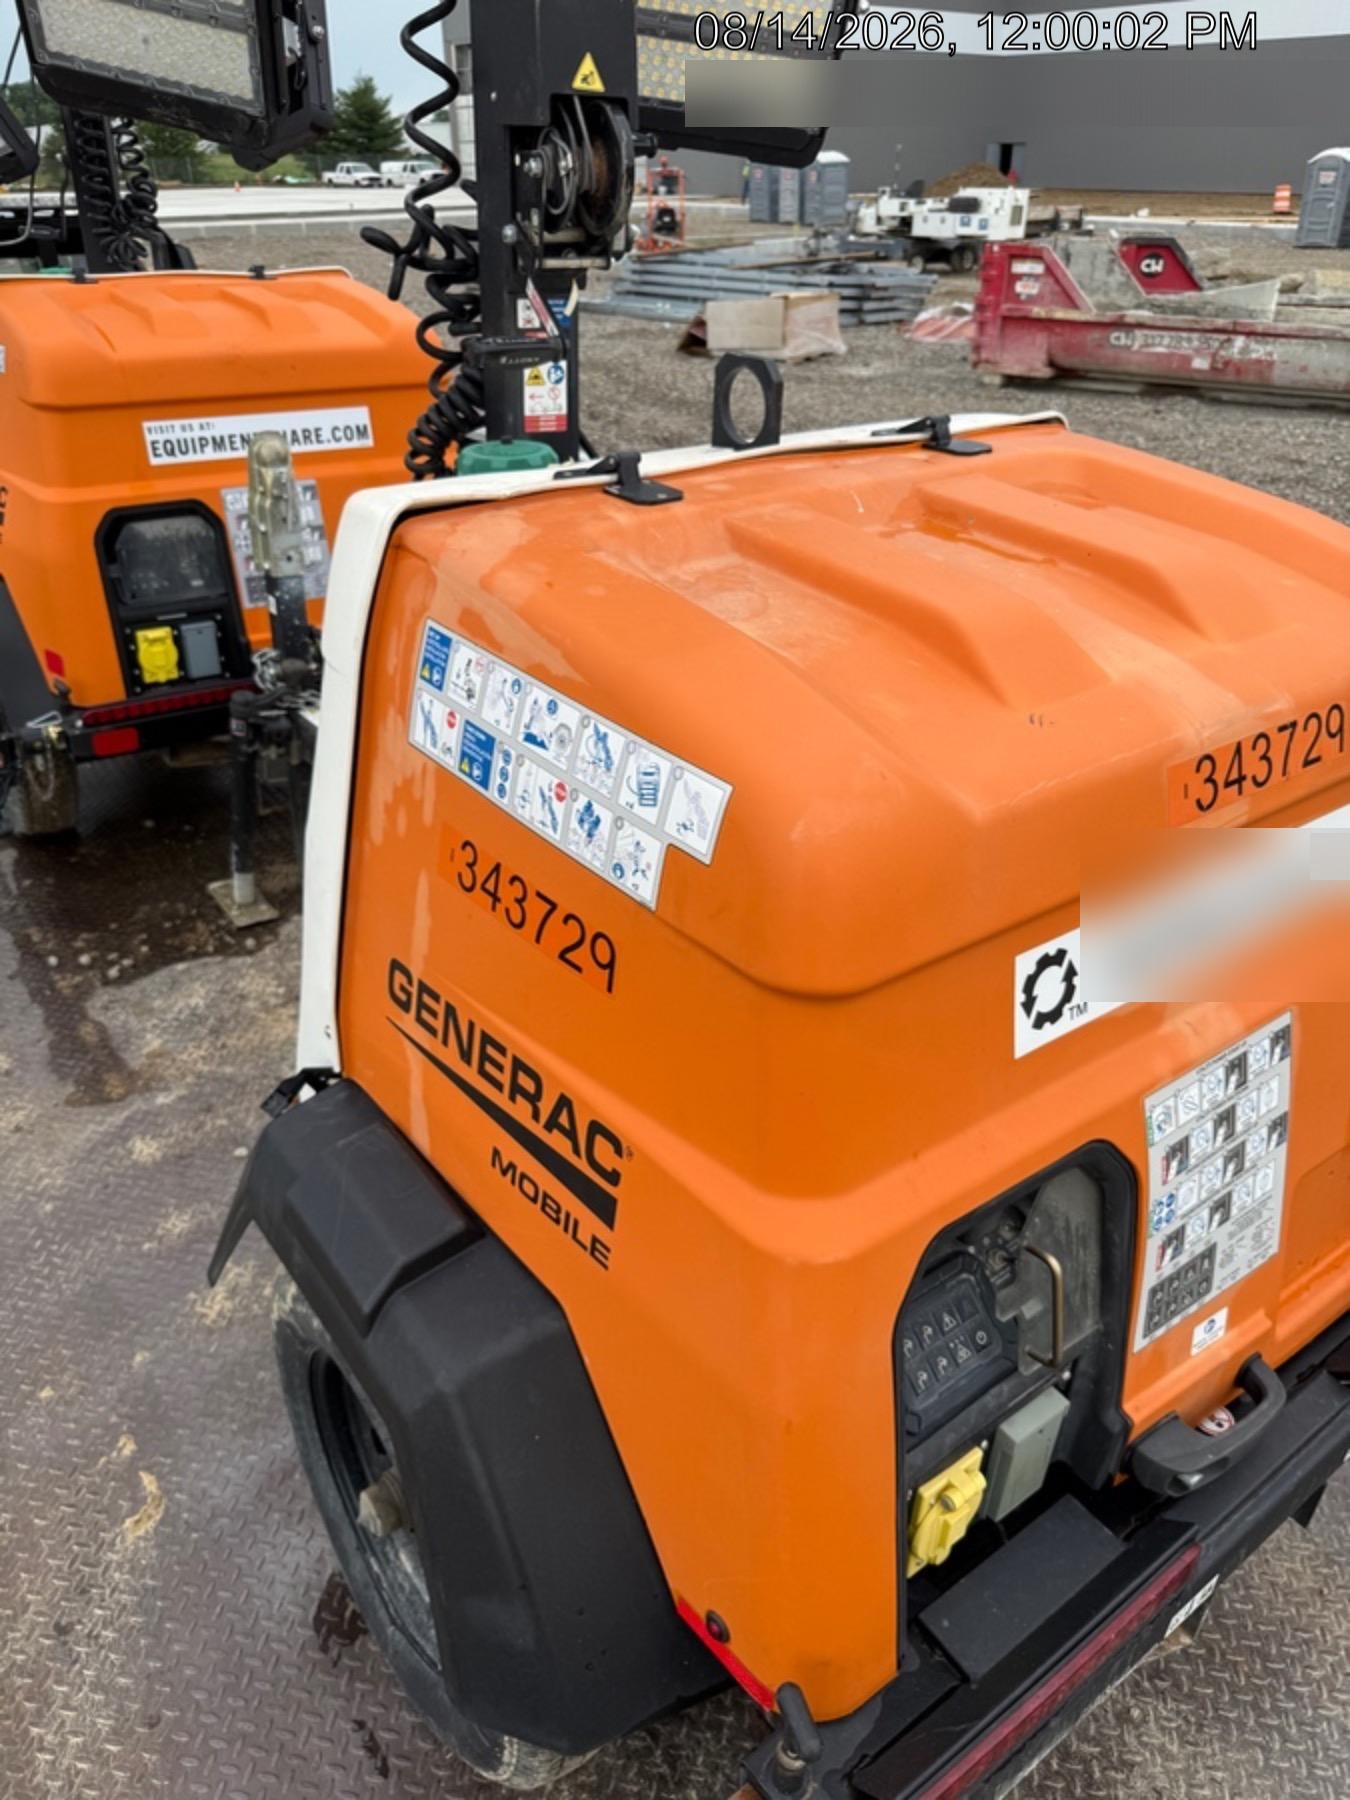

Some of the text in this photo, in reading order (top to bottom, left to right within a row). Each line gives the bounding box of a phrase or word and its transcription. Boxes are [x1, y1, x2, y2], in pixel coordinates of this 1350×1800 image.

[146, 424, 175, 435] VISIT
[180, 423, 194, 433] US
[151, 424, 369, 458] EQUIPMENARE.COM
[1195, 703, 1344, 812] 343729
[457, 839, 616, 993] 343729
[388, 957, 624, 1188] GENERAC
[491, 1146, 612, 1272] MOBILE
